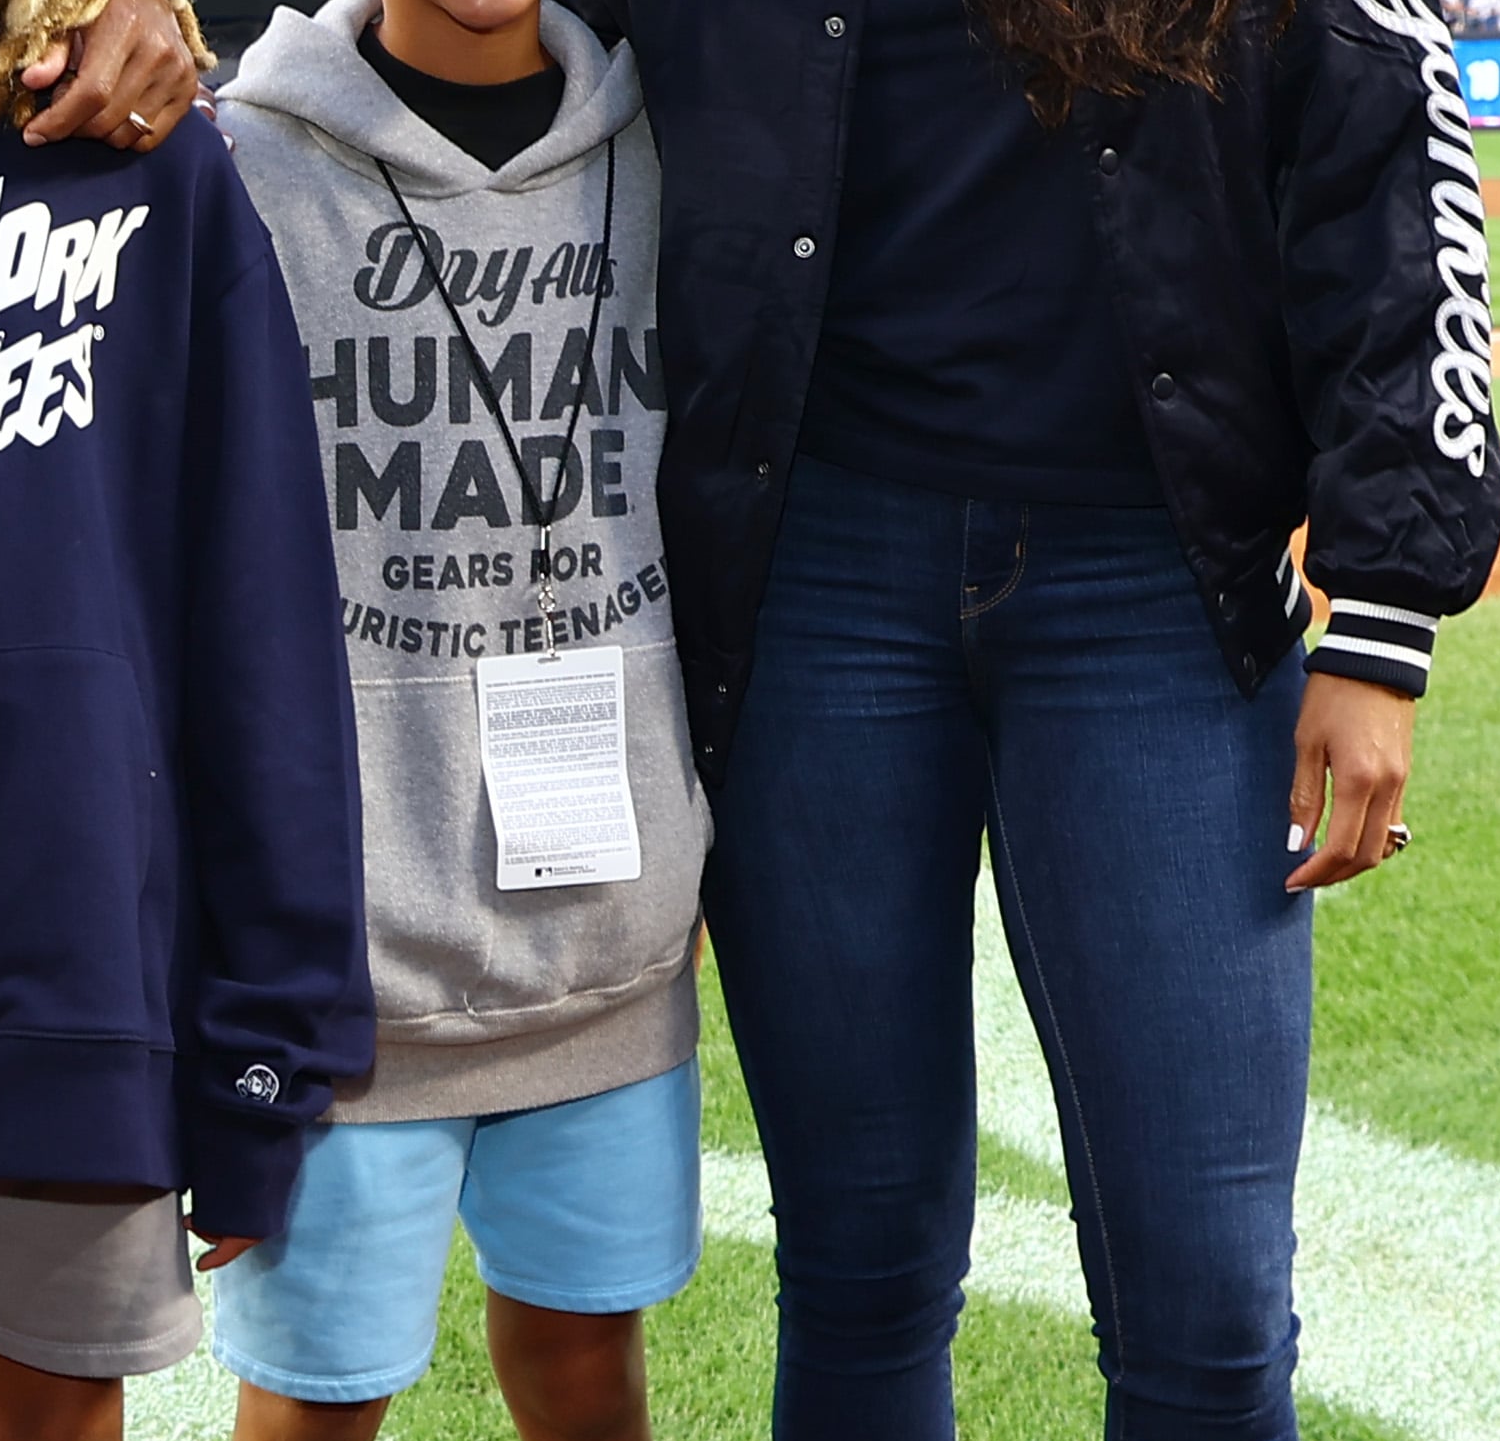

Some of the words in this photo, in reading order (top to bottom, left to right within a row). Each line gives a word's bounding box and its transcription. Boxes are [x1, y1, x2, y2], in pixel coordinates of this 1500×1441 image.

[352, 220, 535, 328] Dry
[302, 325, 668, 429] HUMAN
[335, 428, 629, 532] MADE
[381, 552, 514, 592] GEARS
